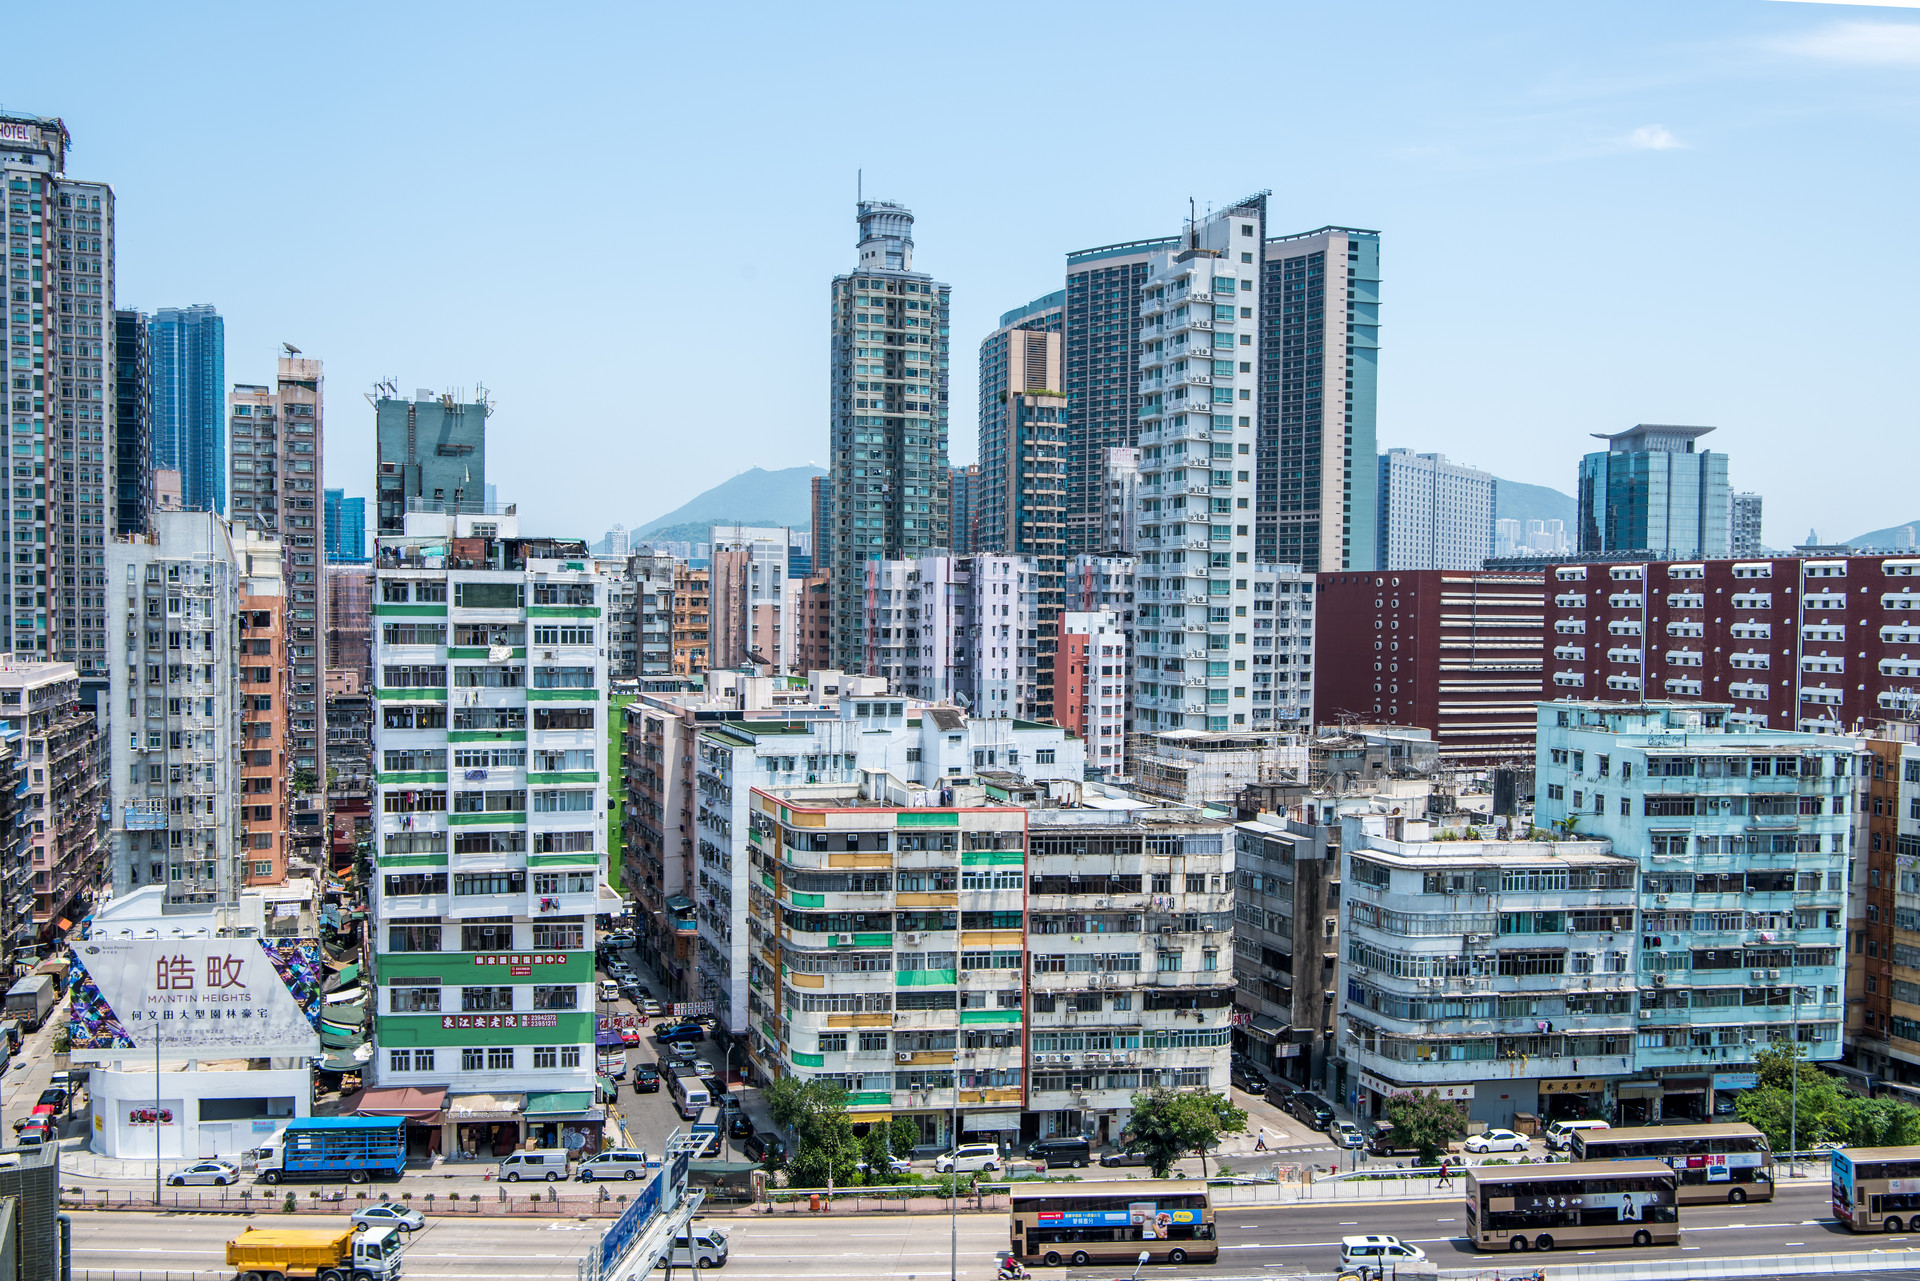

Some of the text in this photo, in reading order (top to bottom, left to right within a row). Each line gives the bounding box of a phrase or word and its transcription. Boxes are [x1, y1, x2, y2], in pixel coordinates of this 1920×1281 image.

[148, 993, 252, 1003] MANTIN HEIGHTS
[132, 1008, 268, 1021] 何文田大型園林豪宅
[443, 1016, 517, 1028] 東江安老院
